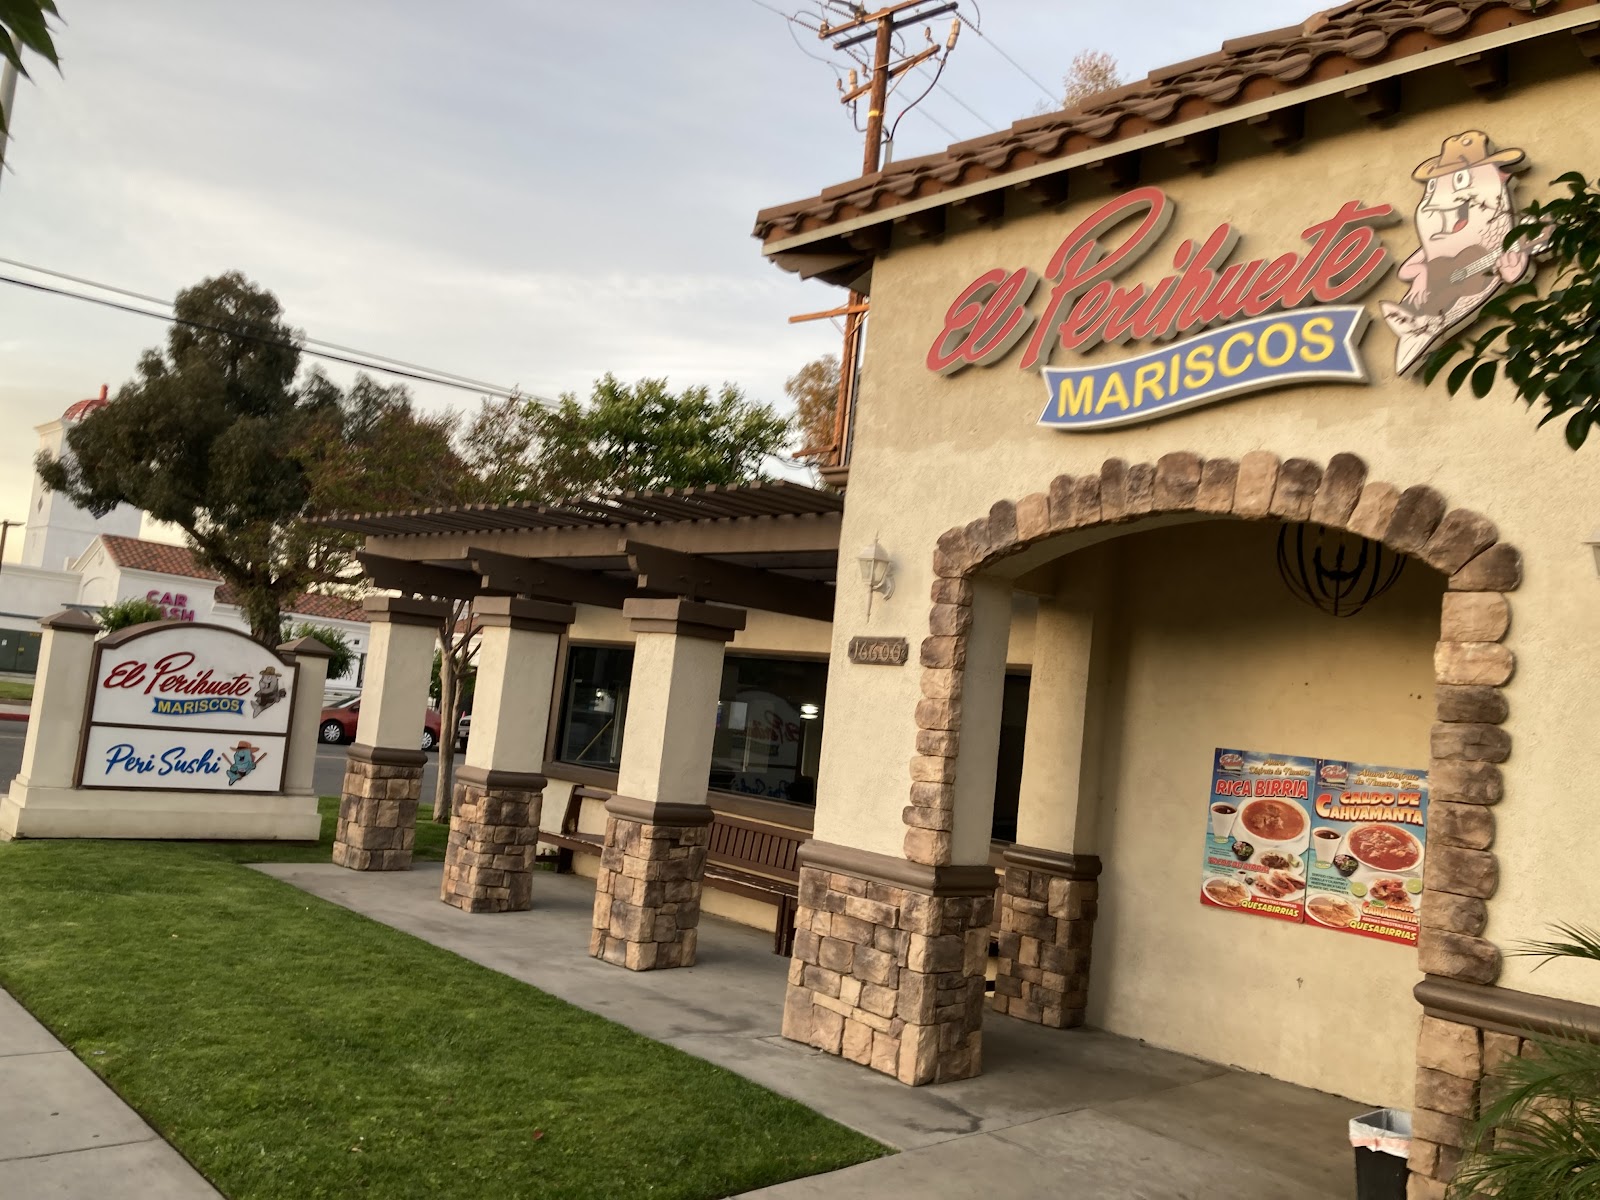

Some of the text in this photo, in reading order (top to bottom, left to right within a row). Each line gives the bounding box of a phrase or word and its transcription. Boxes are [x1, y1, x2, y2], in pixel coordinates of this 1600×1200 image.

[926, 186, 1394, 372] El Perihuete
[1057, 317, 1335, 417] MARISCOS
[146, 590, 188, 607] CAR
[157, 605, 195, 622] ASH
[103, 652, 254, 696] El Perihuete
[157, 699, 239, 713] MARISCOS
[105, 744, 221, 776] Peri Sushi
[1215, 778, 1309, 799] RICA BIRRIA
[1340, 791, 1421, 807] CALDO DE
[1315, 793, 1424, 827] CAHUAMANTA
[1241, 900, 1300, 917] QUESABIRRIAS
[1349, 920, 1418, 941] QUESABIRRIAS
